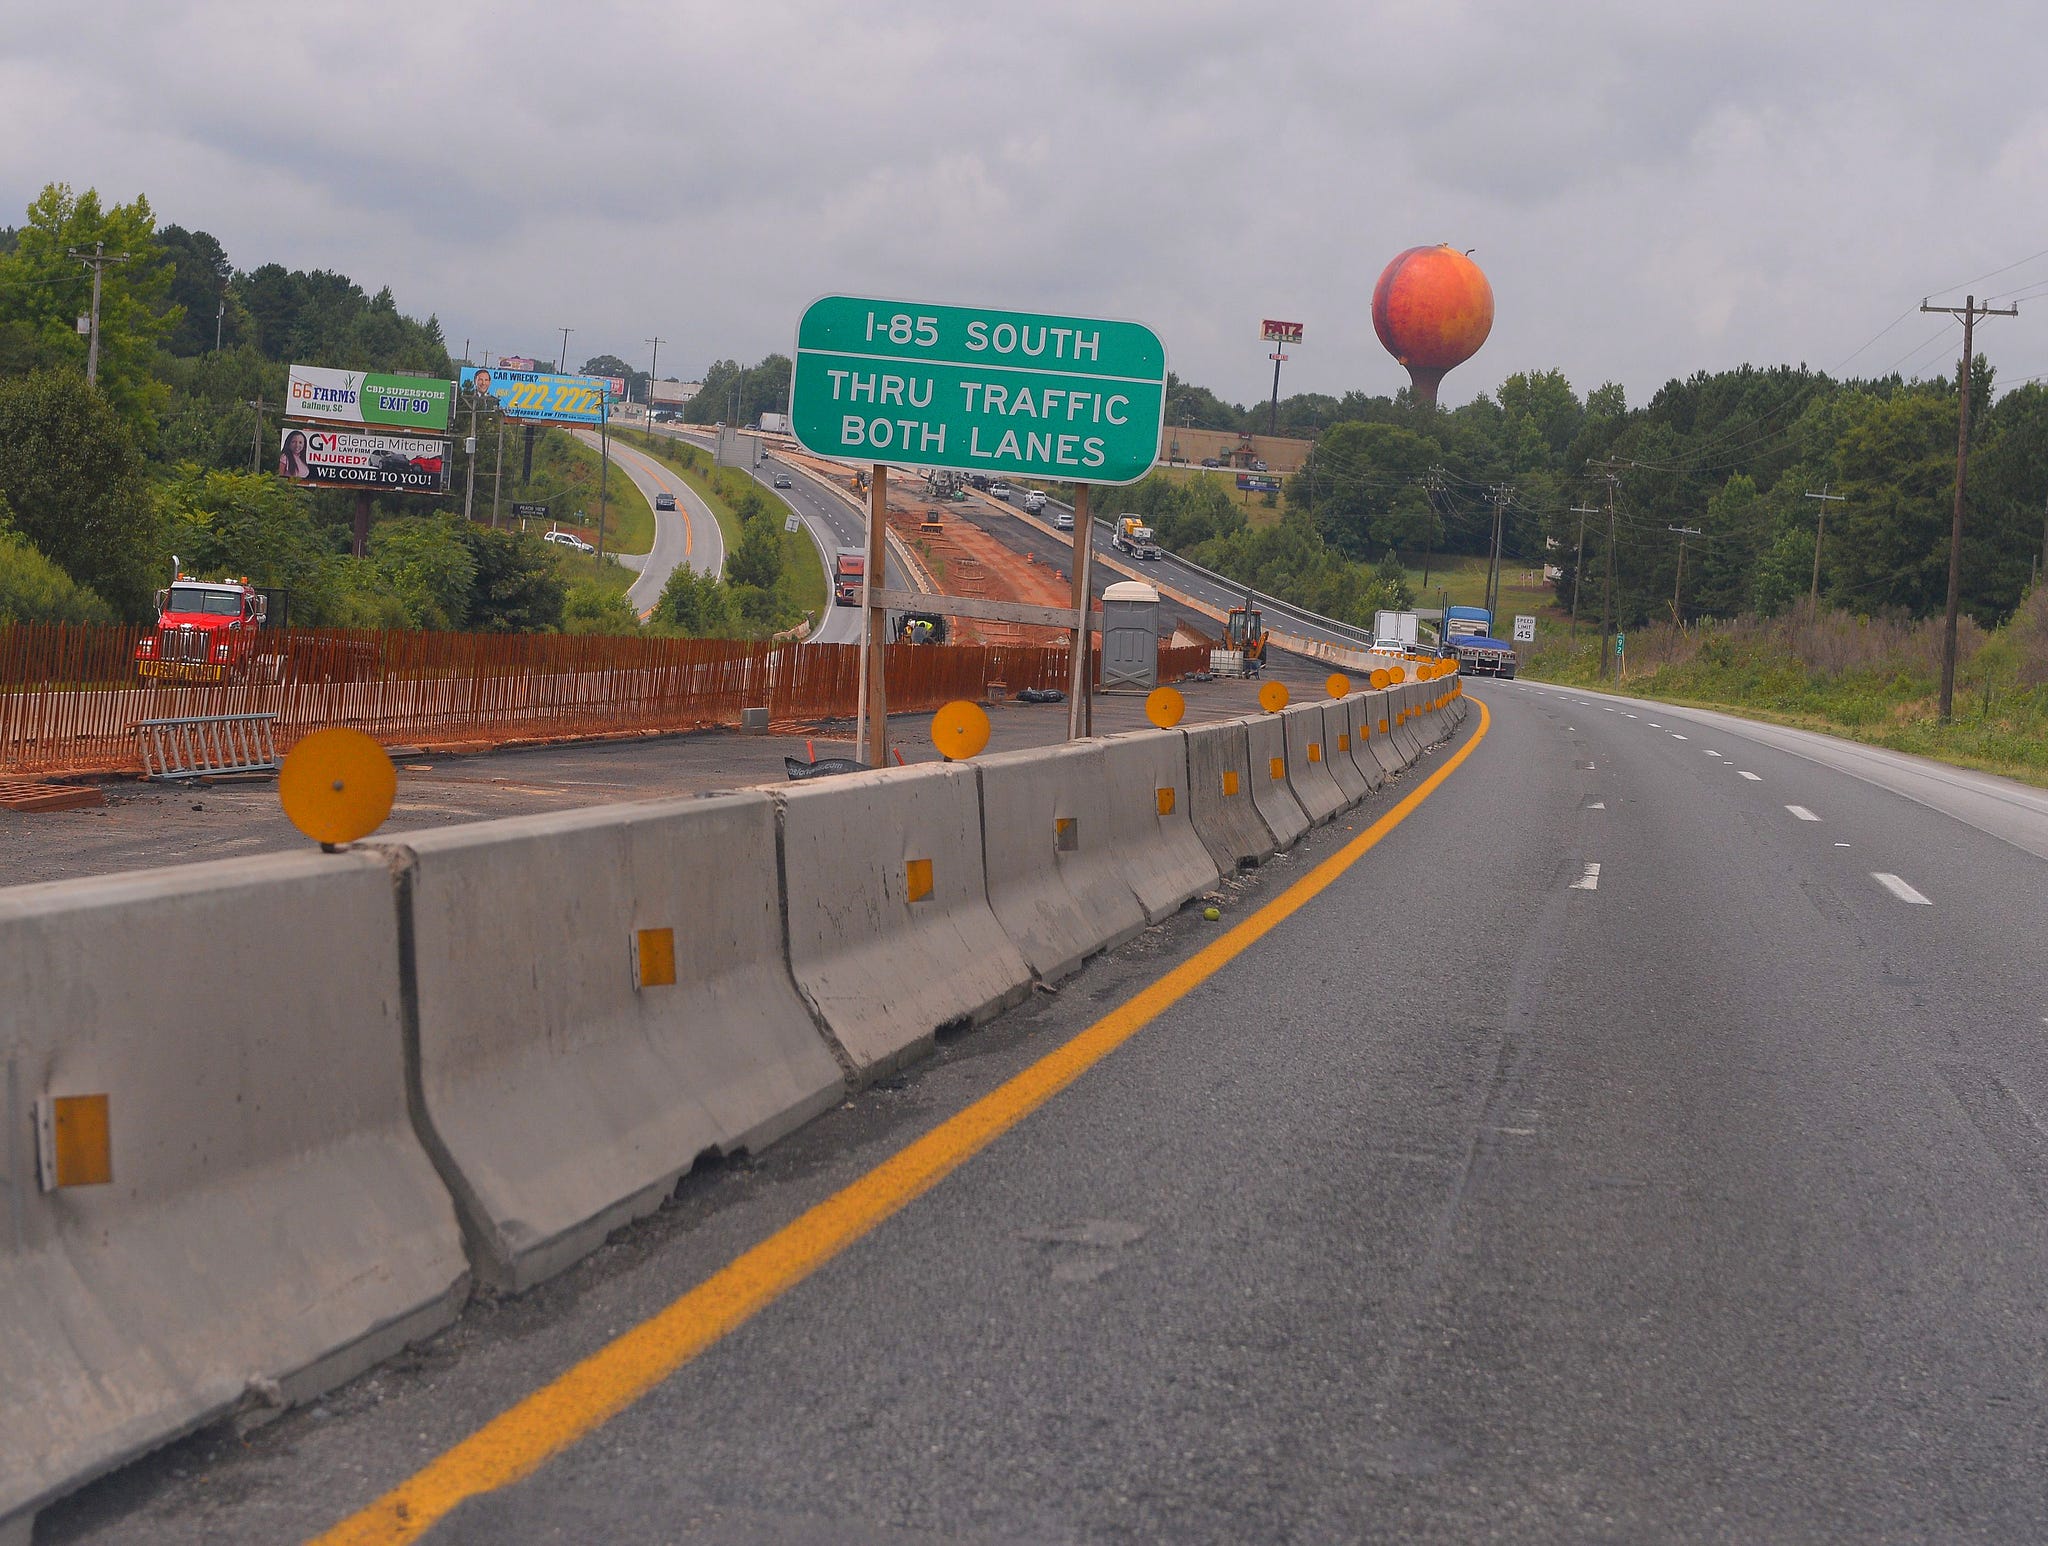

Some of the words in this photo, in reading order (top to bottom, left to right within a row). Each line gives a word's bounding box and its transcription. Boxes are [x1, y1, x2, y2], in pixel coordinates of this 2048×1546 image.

[866, 312, 939, 347] I-85
[965, 321, 1101, 361] SOUTH
[1263, 320, 1303, 336] FATZ
[493, 371, 509, 381] CAR
[510, 373, 539, 383] WRECK?
[292, 382, 312, 399] 66
[313, 387, 356, 404] FARMS
[366, 385, 385, 393] CBD
[386, 387, 445, 399] SUPERSTORE
[508, 382, 604, 415] 222-2222
[827, 370, 934, 408] THRU
[960, 381, 1130, 426] TRAFFIC
[379, 396, 410, 412] EXIT
[412, 399, 429, 414] 90
[308, 433, 337, 452] GM
[338, 435, 384, 449] Glenda
[388, 438, 441, 453] Mitchell
[841, 415, 946, 453] BOTH
[970, 427, 1105, 467] LANES
[309, 452, 368, 465] INJURED?
[316, 466, 337, 477] WE
[339, 468, 377, 481] COME
[379, 472, 398, 482] TO
[401, 474, 432, 486] YOU!
[1516, 630, 1531, 639] 45
